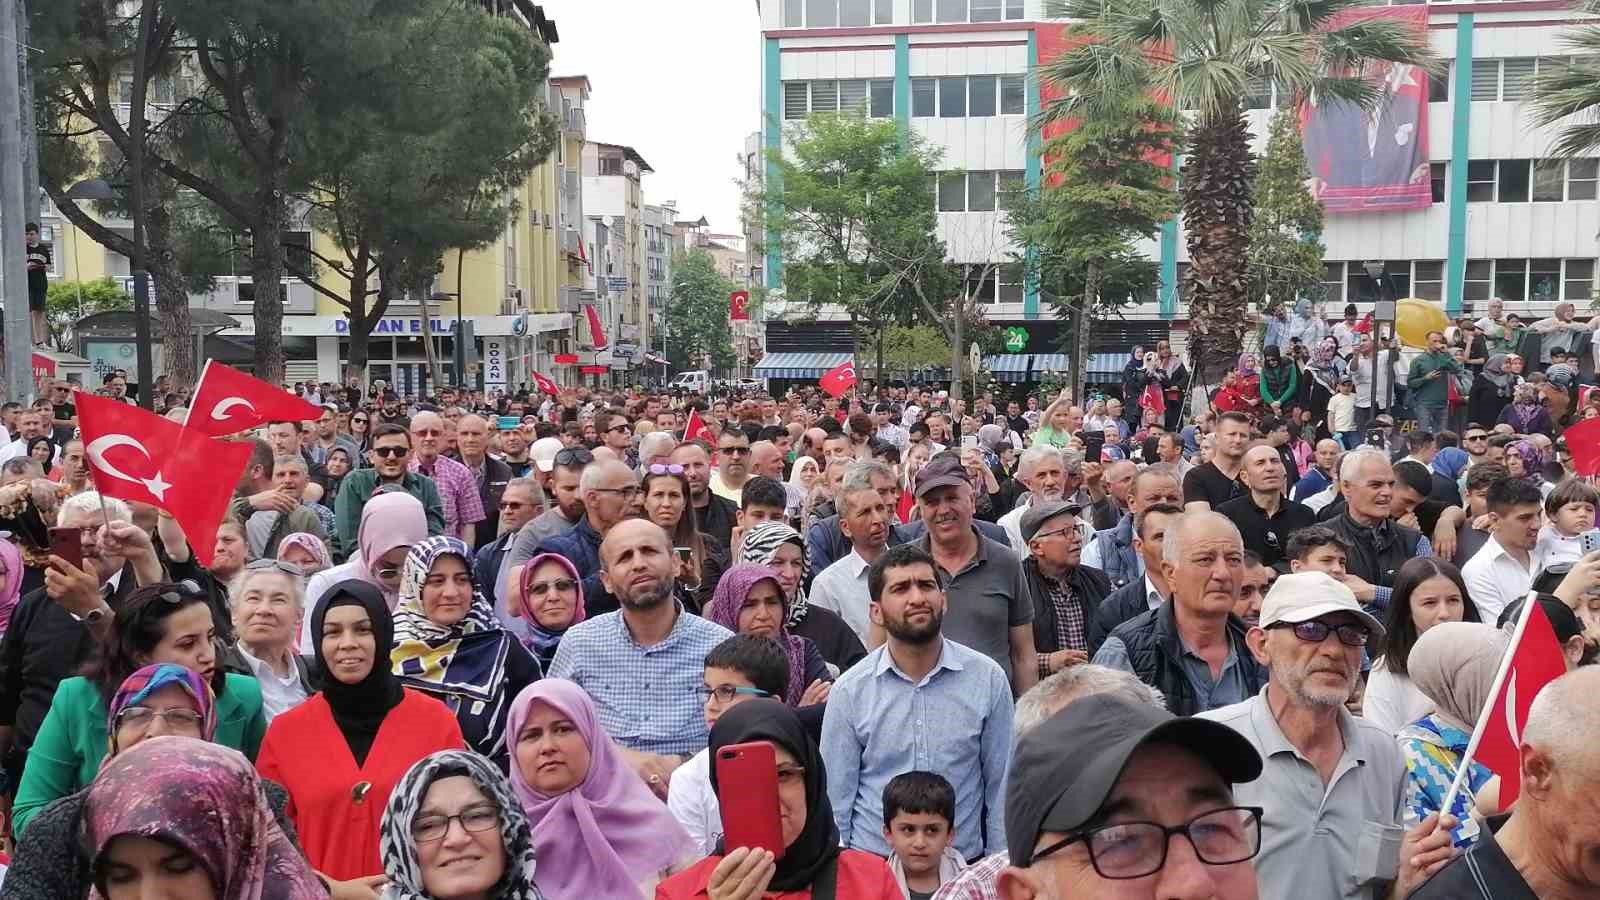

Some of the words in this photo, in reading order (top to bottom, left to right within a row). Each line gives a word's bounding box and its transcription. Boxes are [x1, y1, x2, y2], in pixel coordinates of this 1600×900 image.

[336, 319, 403, 332] DAN
[410, 319, 474, 332] ELA
[1007, 331, 1024, 348] 24
